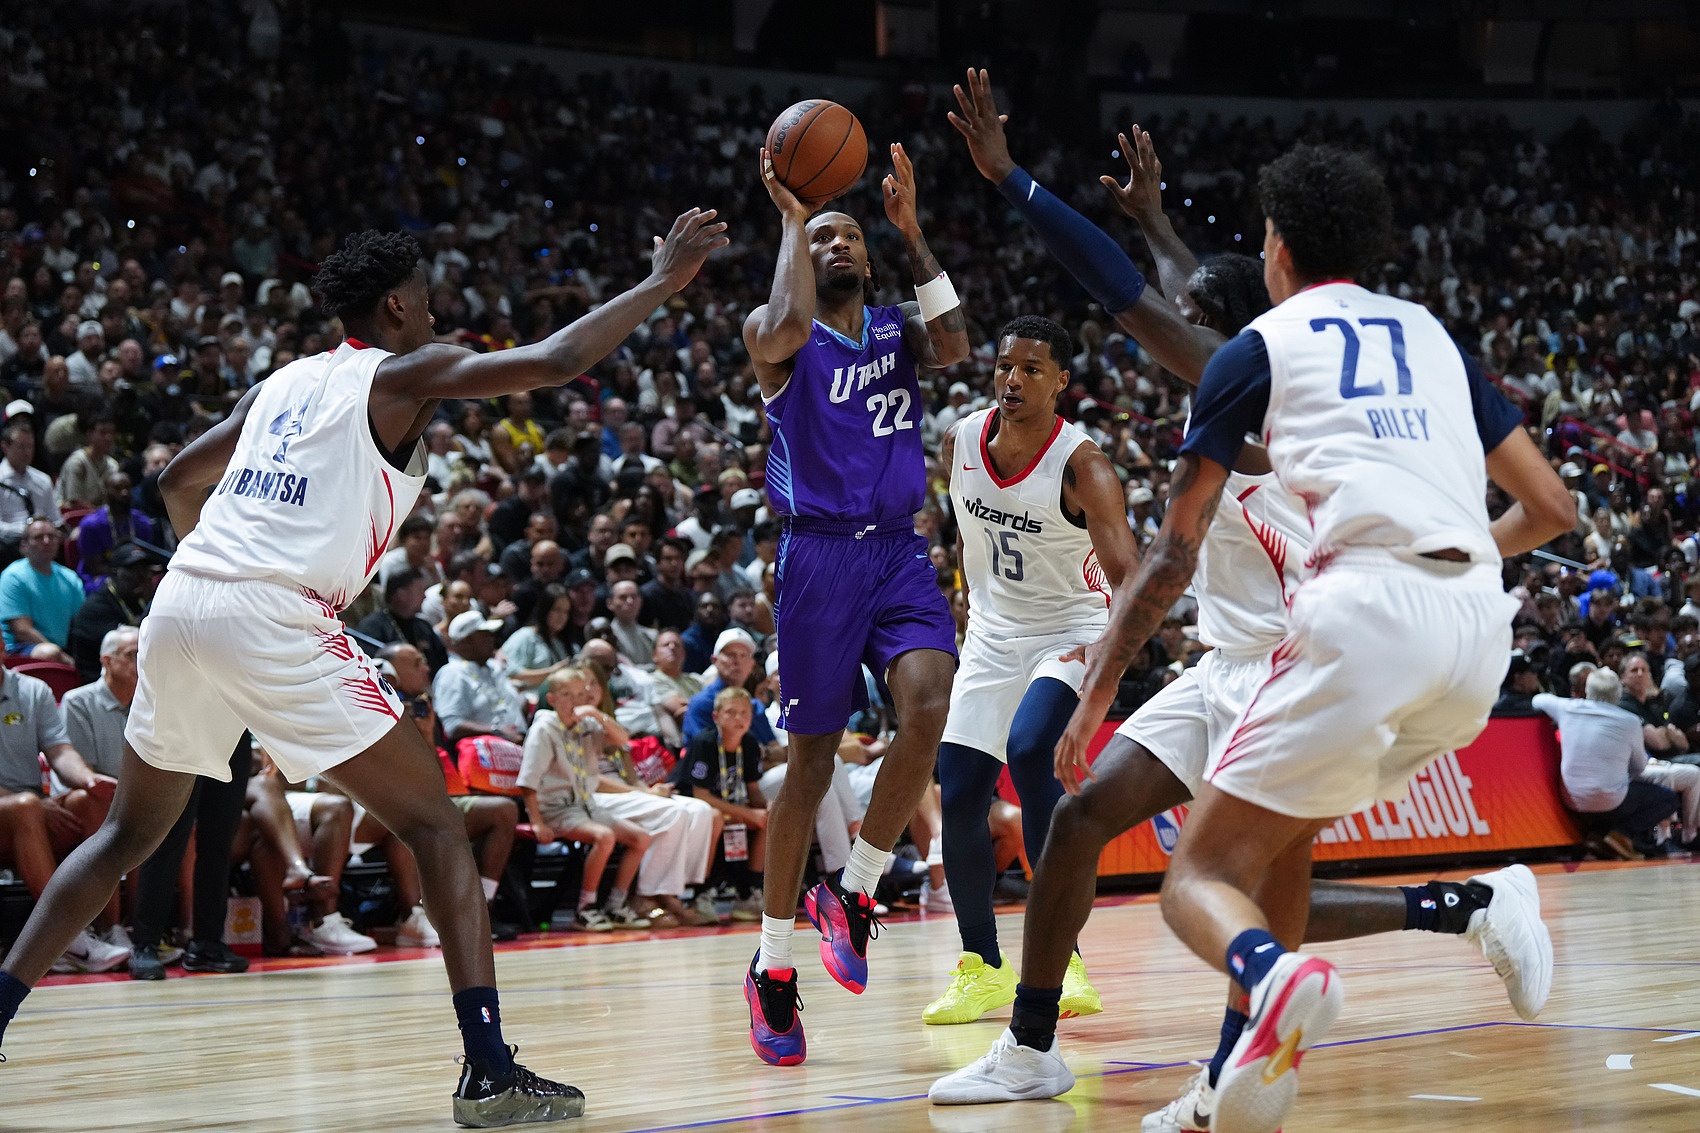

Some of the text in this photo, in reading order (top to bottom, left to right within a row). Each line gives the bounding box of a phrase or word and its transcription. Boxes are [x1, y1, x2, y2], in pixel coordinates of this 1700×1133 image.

[871, 322, 899, 334] Health
[875, 329, 901, 340] Equity
[829, 352, 896, 404] UTAH
[1309, 317, 1412, 399] 27
[866, 388, 913, 438] 22
[1366, 408, 1429, 441] RILEY
[962, 496, 1043, 533] wizards
[984, 527, 1024, 581] 15
